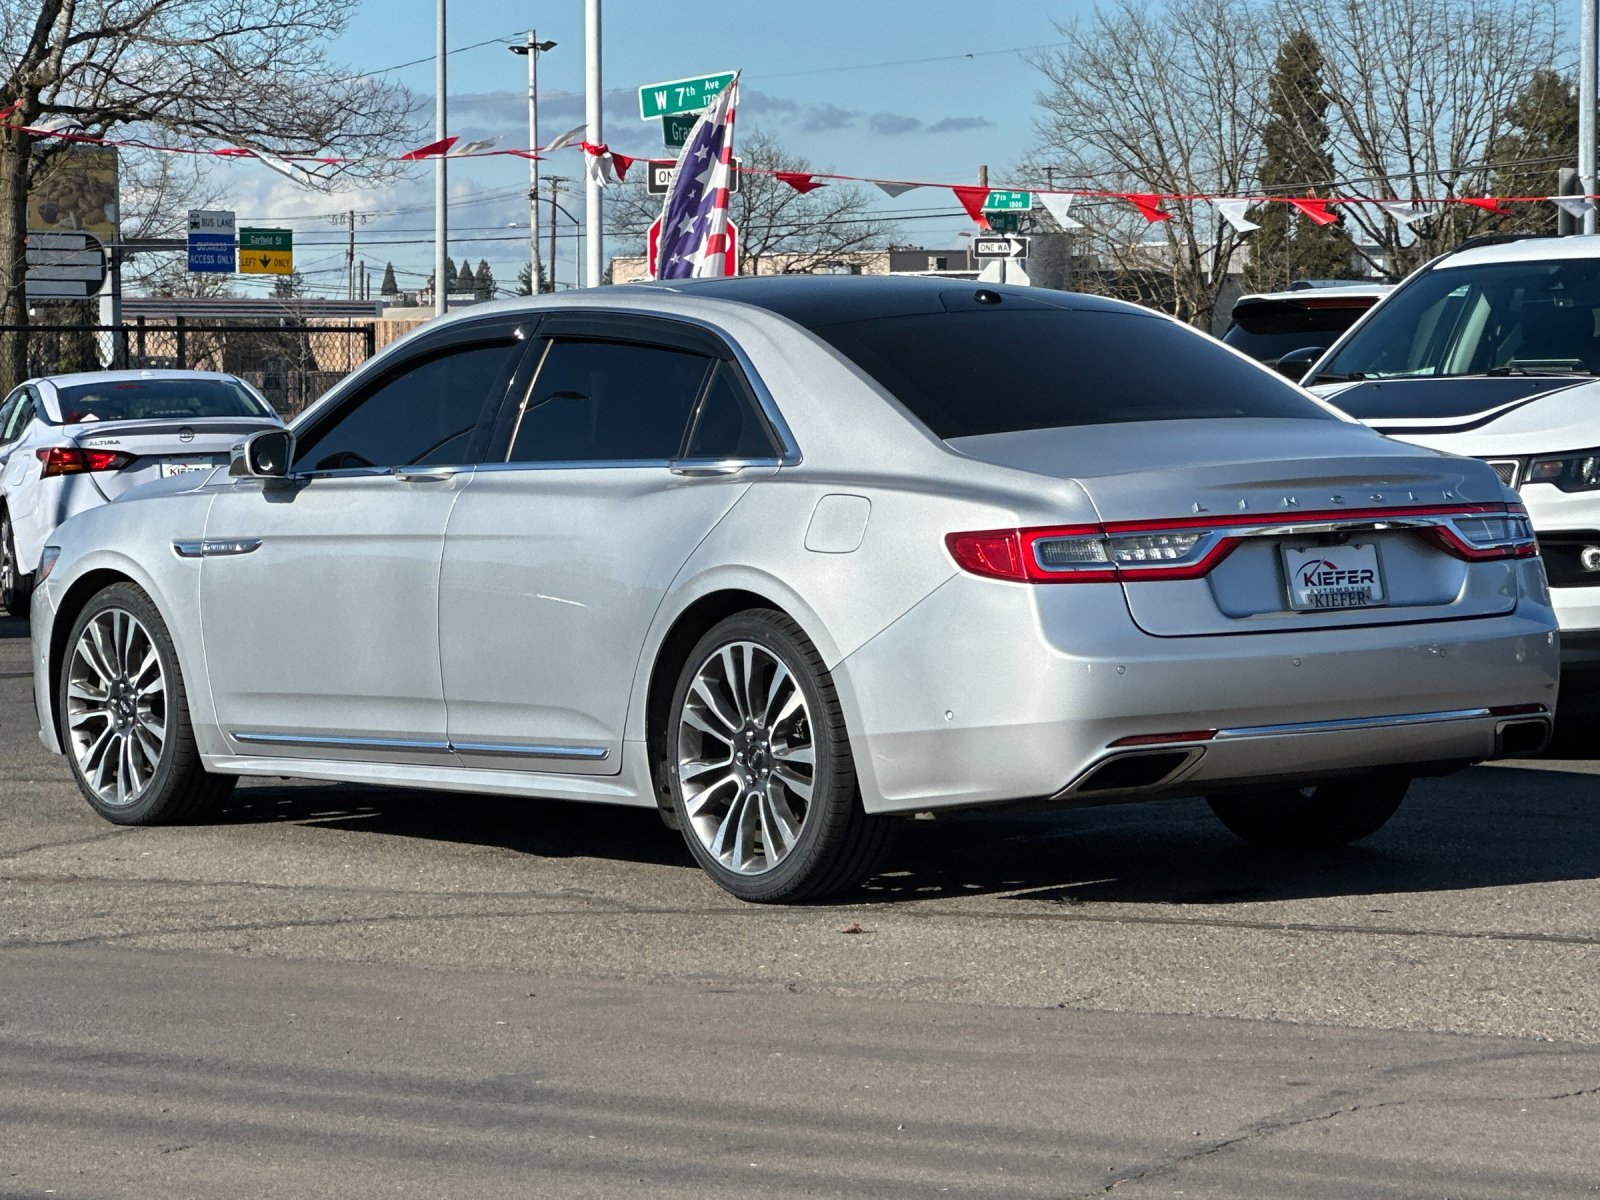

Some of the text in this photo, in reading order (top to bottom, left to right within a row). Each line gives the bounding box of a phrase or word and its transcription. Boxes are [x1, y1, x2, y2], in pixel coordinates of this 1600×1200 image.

[655, 80, 720, 110] W 7th Ave
[658, 170, 673, 183] ON
[993, 193, 1007, 207] 7th
[201, 218, 233, 228] BUS LANE
[196, 242, 228, 252] BUSINESS
[980, 243, 995, 252] ONE
[189, 254, 235, 265] ACCESS ONLY
[241, 257, 290, 268] LEFT ONLY
[88, 439, 121, 447] ALTIMA
[1191, 489, 1454, 514] LINCOLN
[1303, 569, 1375, 587] KIEFER
[1314, 591, 1367, 608] KIEFER
